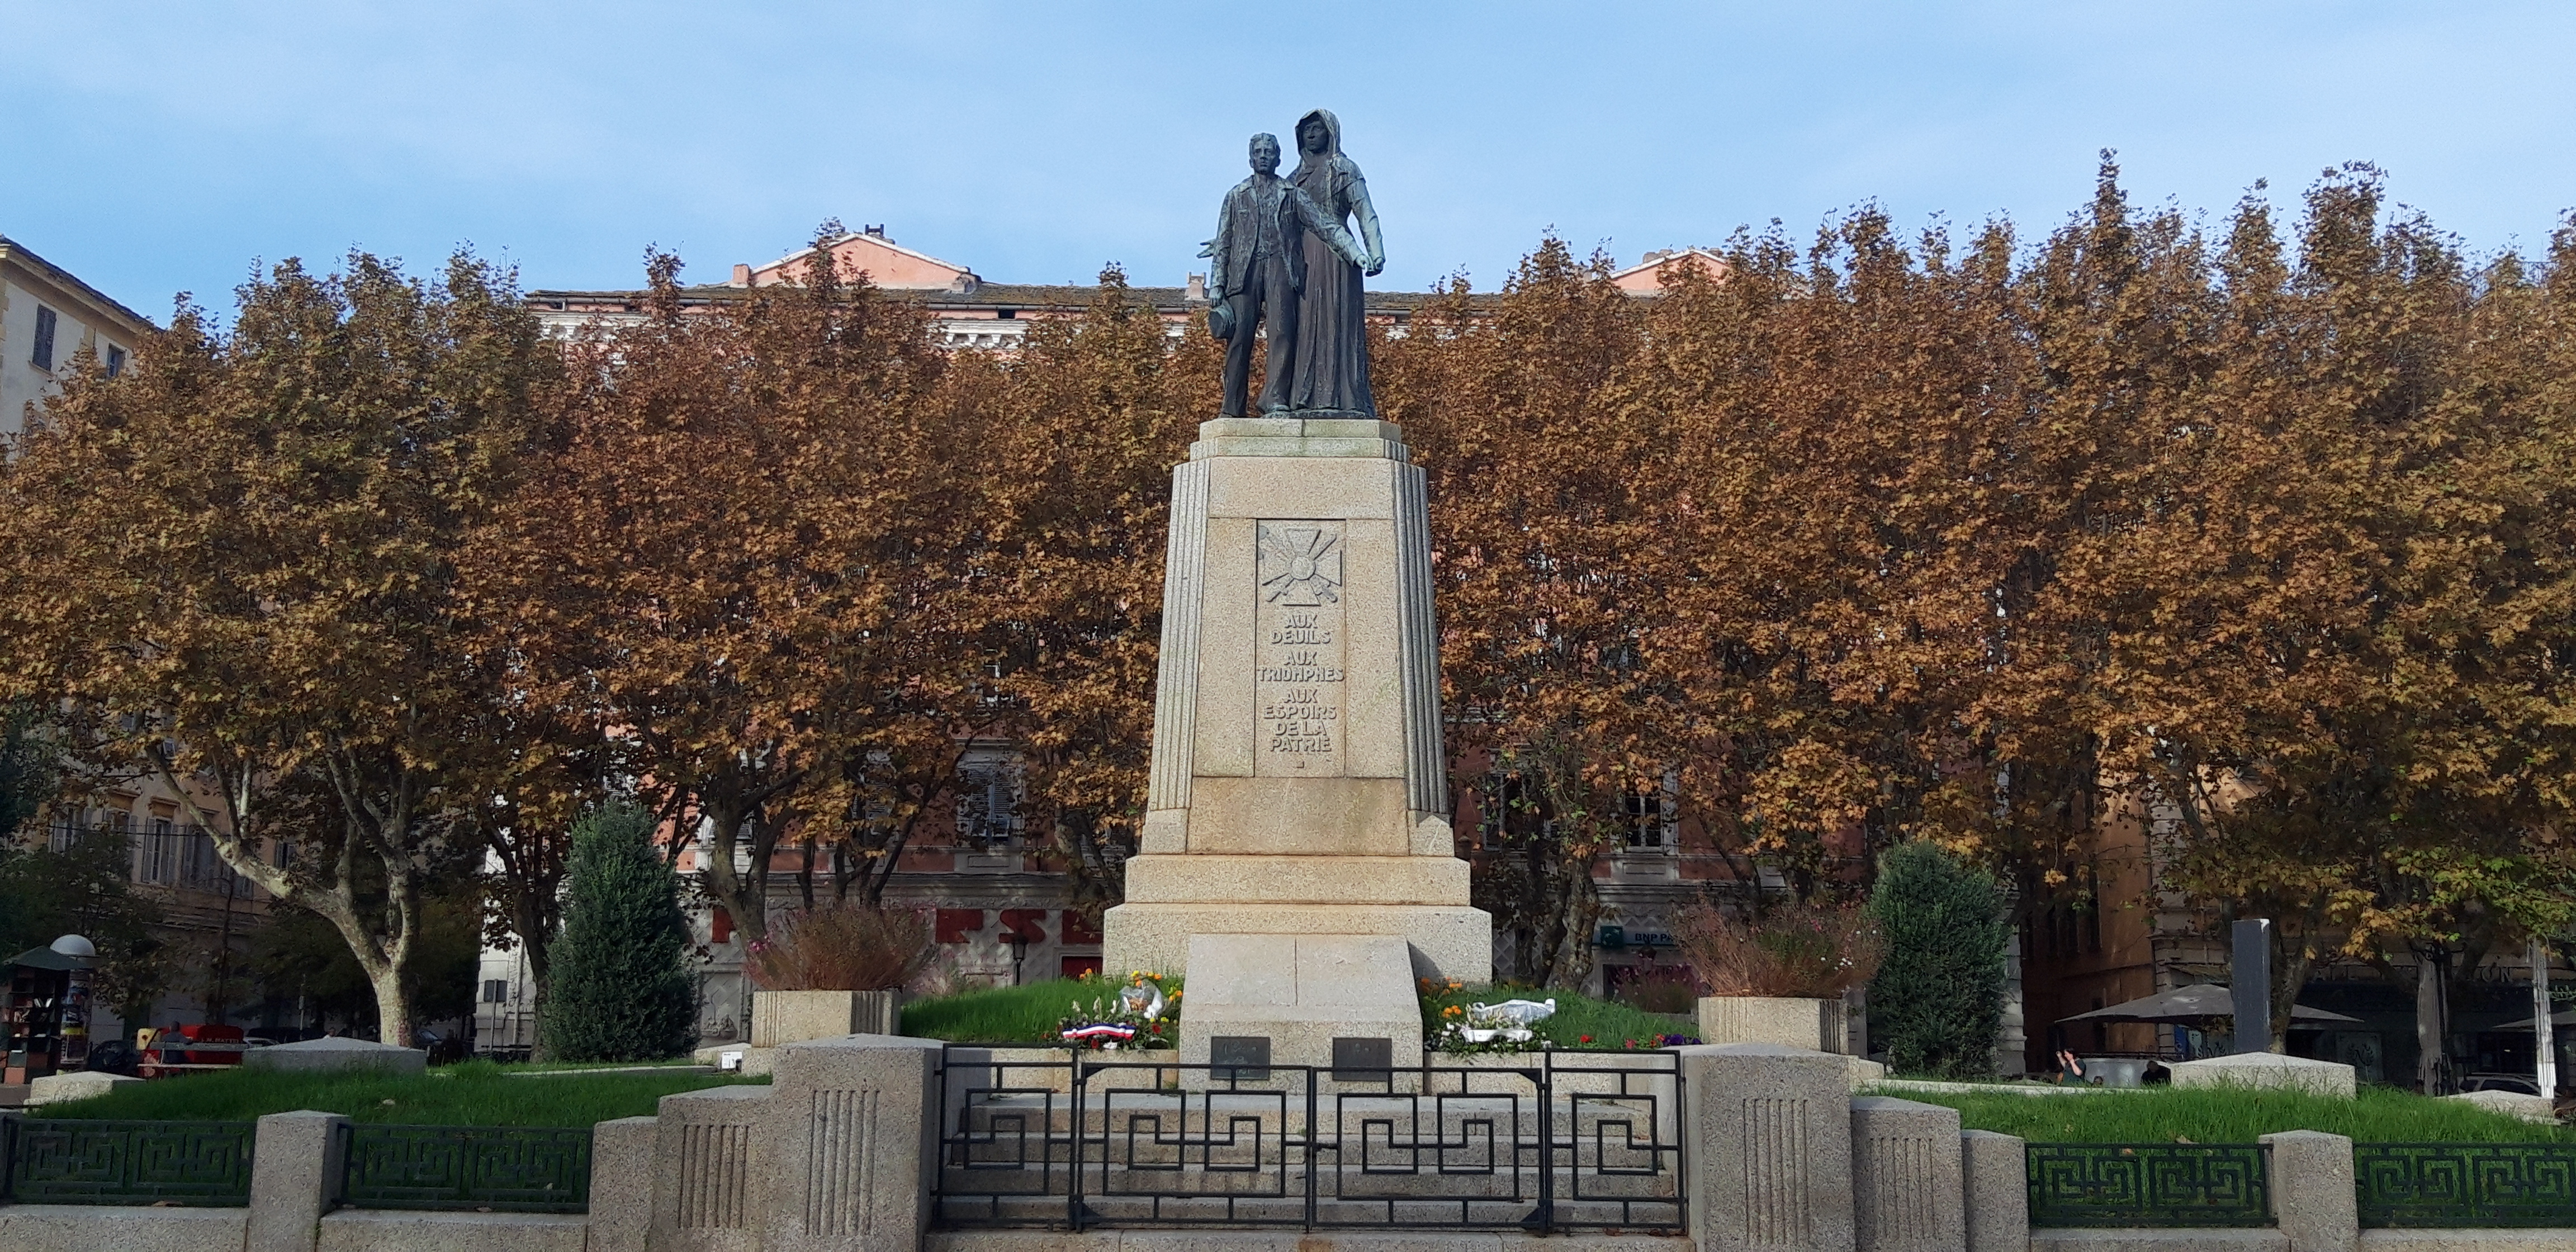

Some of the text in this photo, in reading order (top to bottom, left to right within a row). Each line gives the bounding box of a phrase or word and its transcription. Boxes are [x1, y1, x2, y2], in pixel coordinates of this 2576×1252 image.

[1284, 614, 1318, 629] AUX
[1271, 629, 1331, 644] DEUILS
[1284, 651, 1318, 666] AUX
[1257, 667, 1346, 682] TRIOMPHES
[1284, 688, 1318, 703] AUX
[1263, 704, 1338, 719] ESPOIRS
[1275, 720, 1328, 736] DE LA
[1270, 737, 1332, 752] PATRIE
[1636, 933, 1659, 943] BNP
